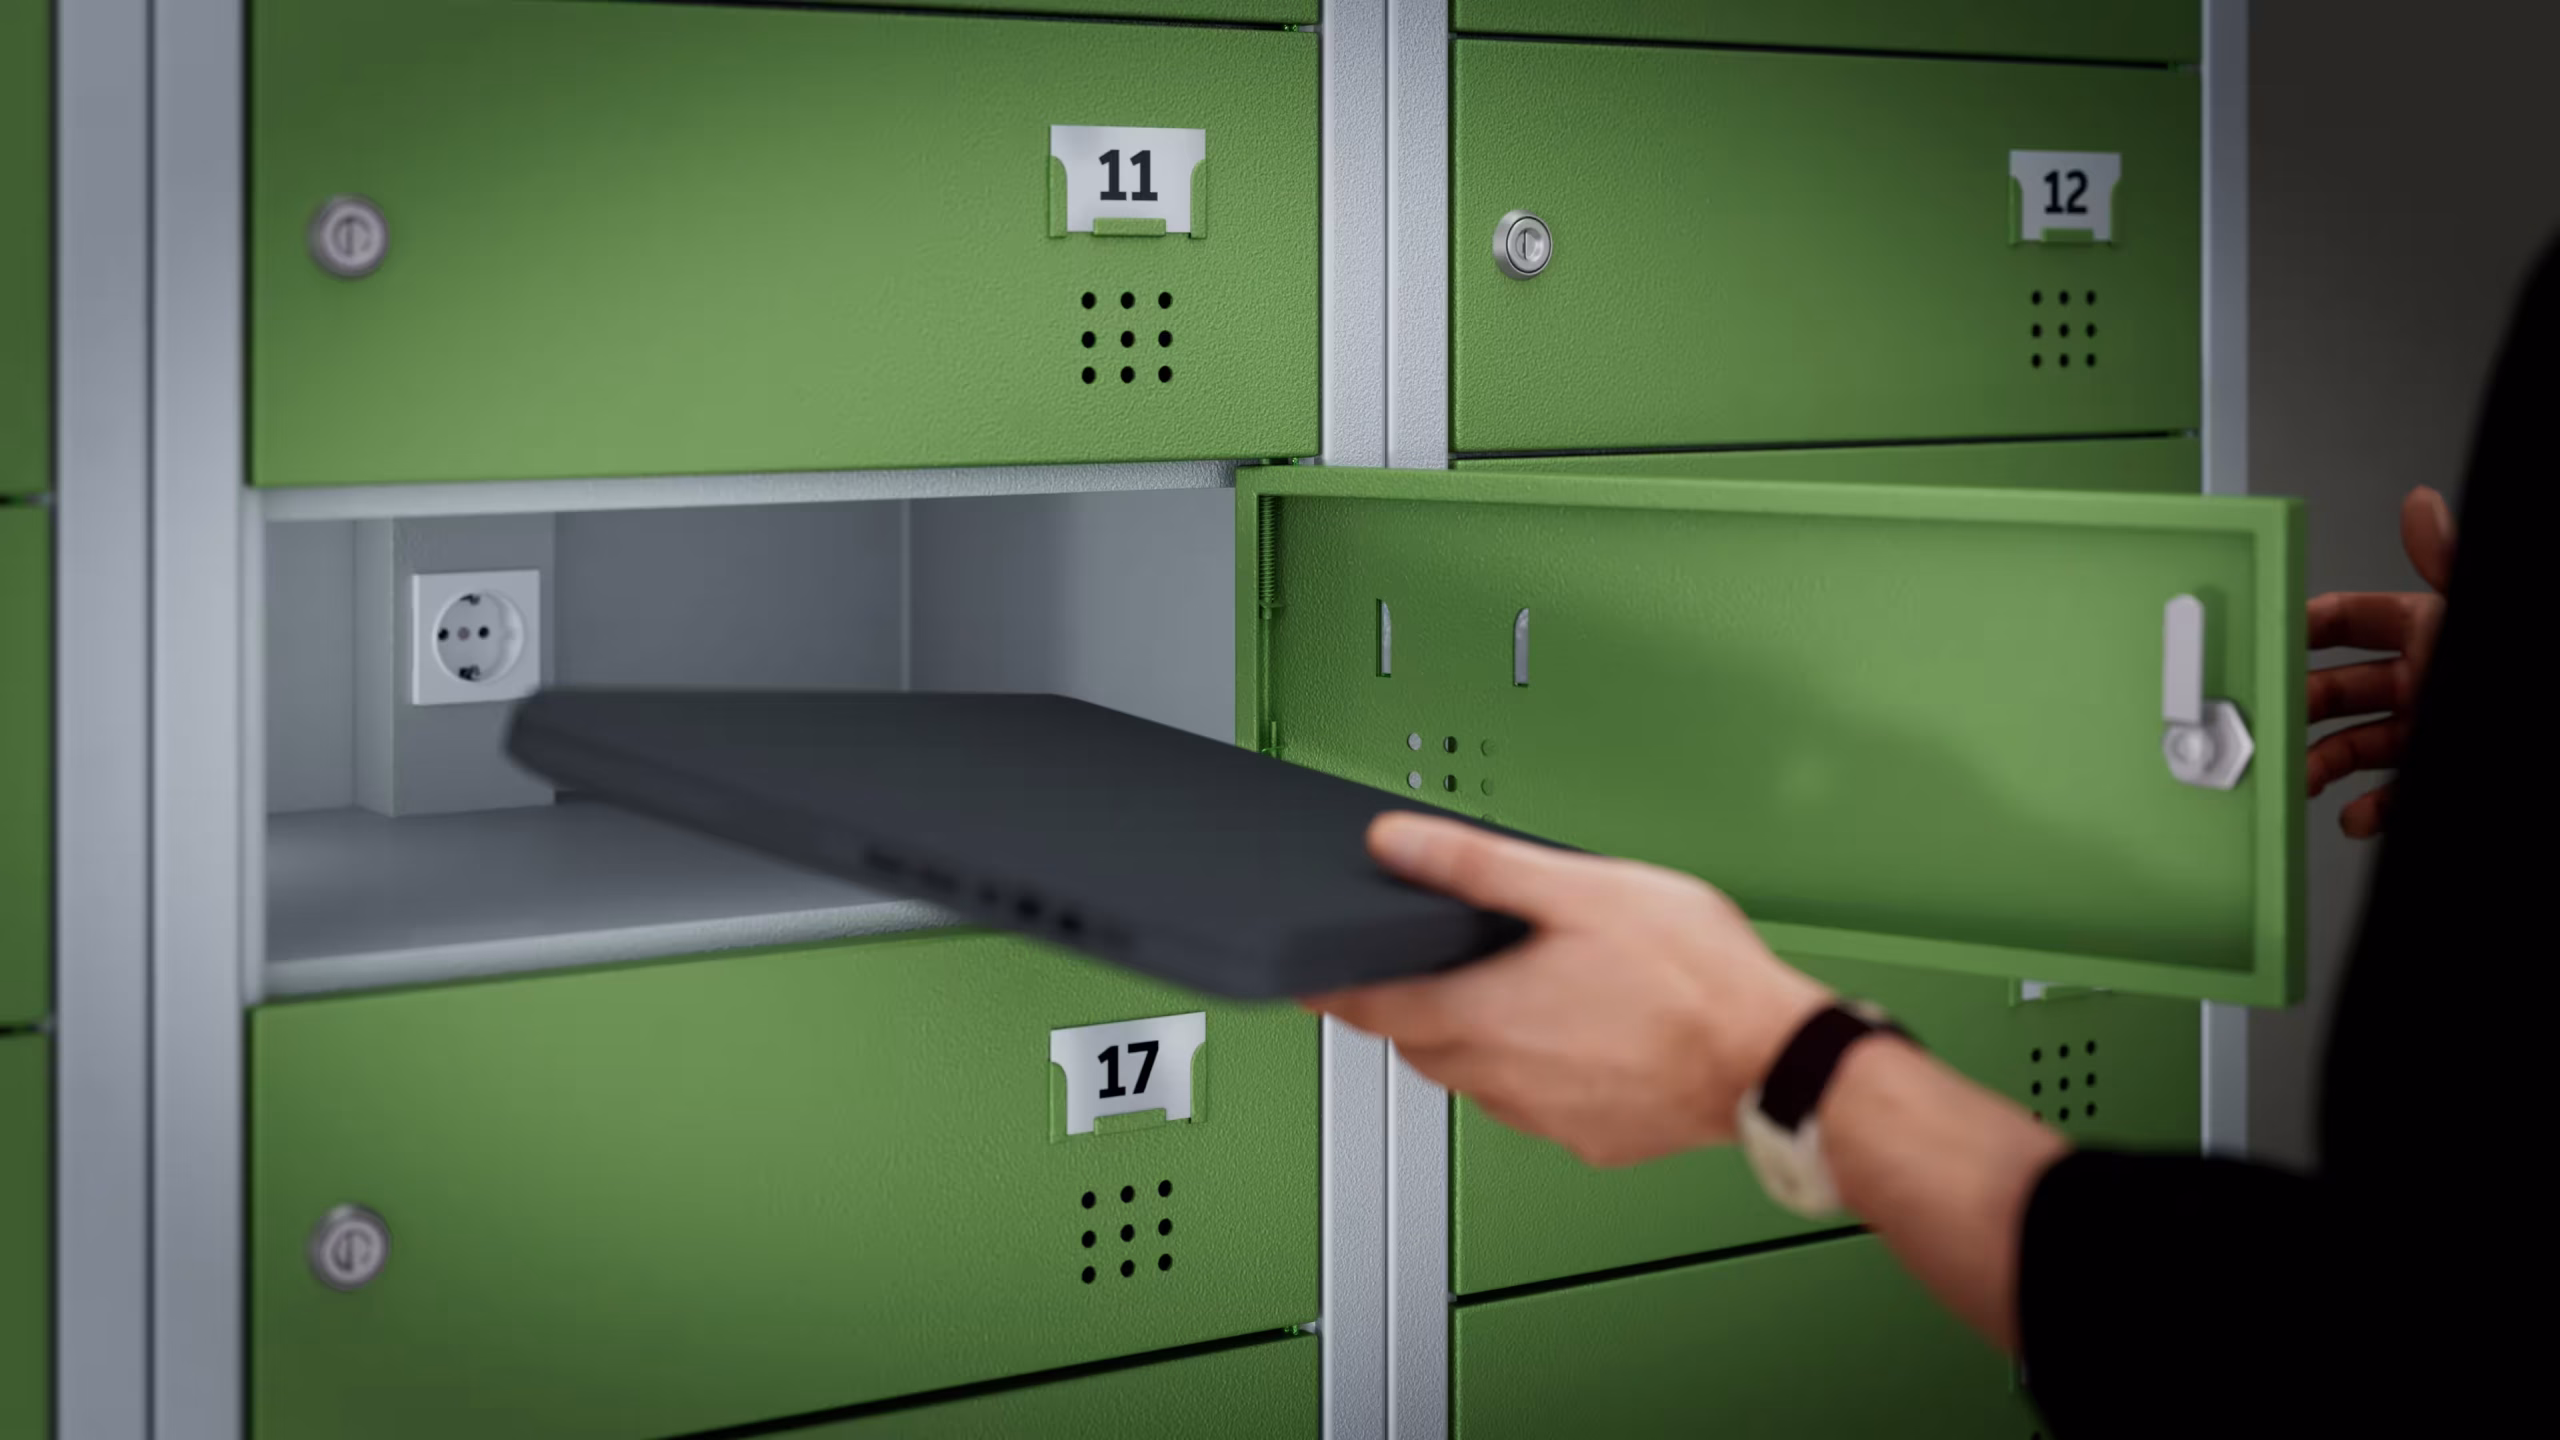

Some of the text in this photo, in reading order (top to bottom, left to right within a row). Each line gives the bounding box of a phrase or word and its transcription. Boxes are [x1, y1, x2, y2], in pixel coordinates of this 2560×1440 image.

[1098, 149, 1158, 201] 11
[2044, 169, 2088, 214] 12
[1097, 1040, 1159, 1099] 17
